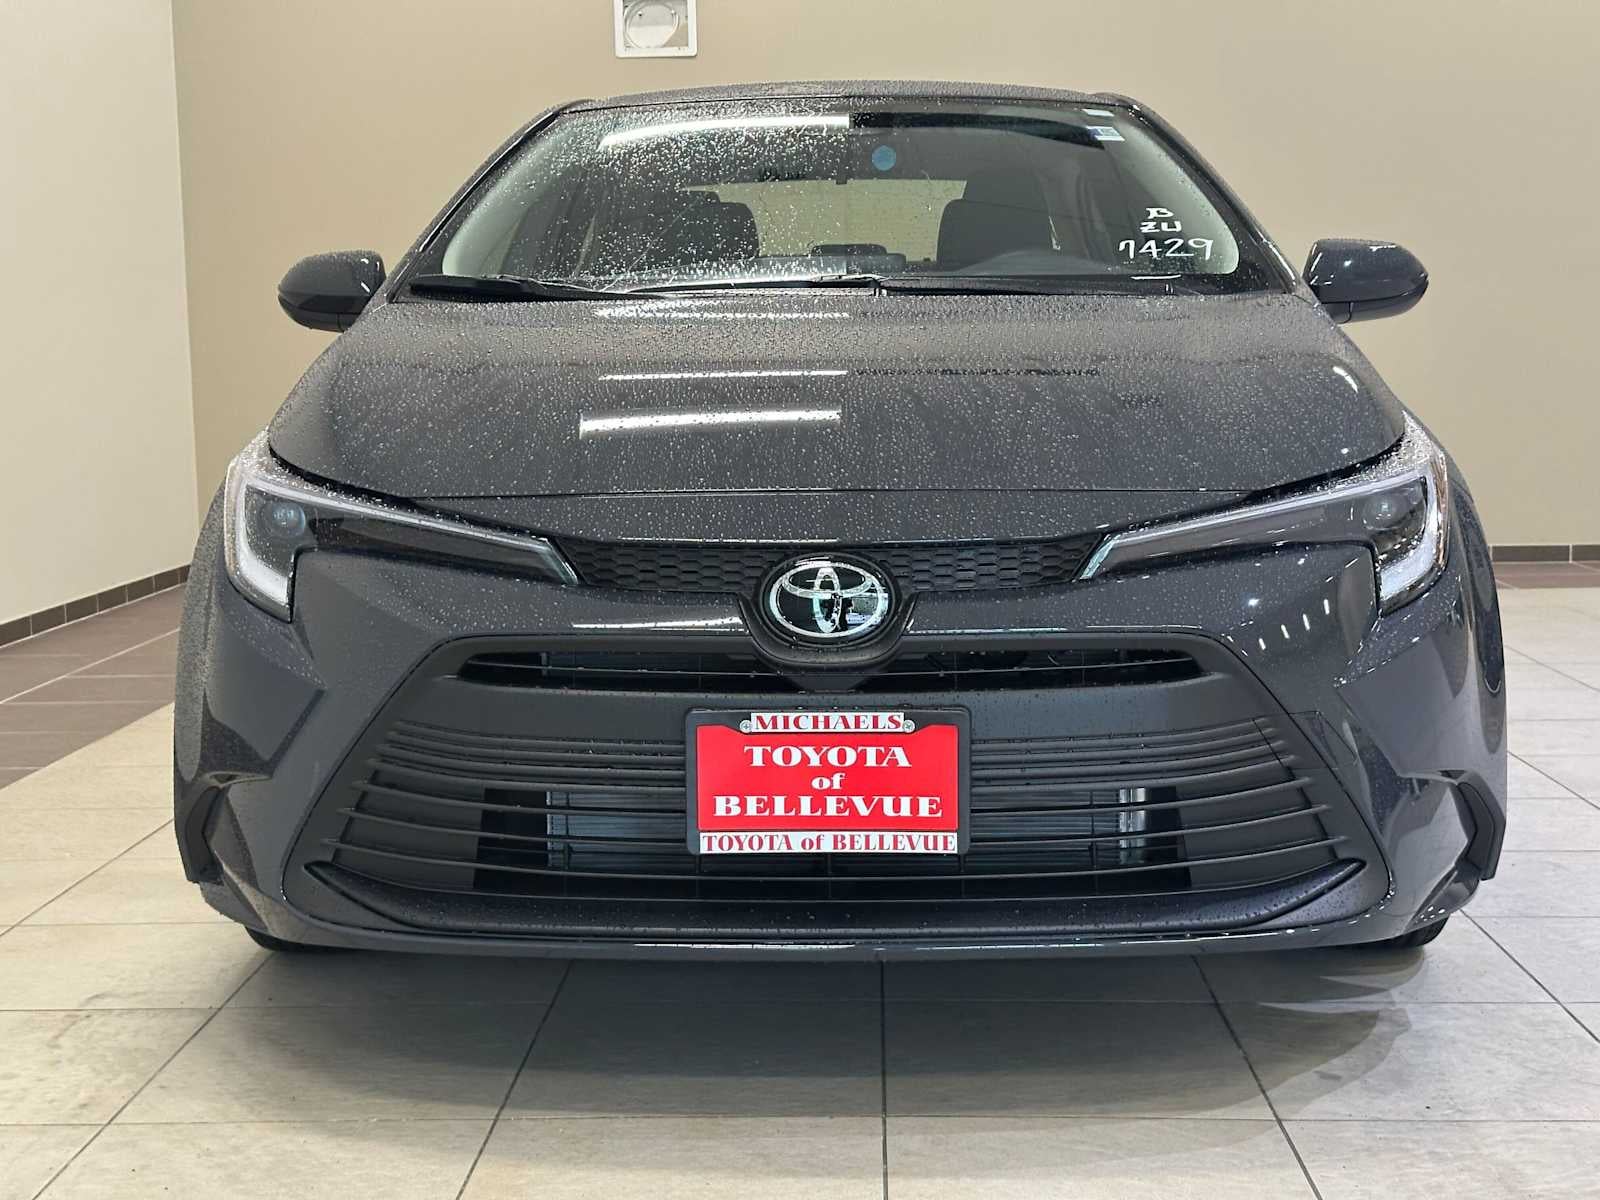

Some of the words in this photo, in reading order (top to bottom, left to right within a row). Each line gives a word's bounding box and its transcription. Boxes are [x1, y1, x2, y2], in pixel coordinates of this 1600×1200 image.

[1118, 238, 1214, 260] 7429
[754, 714, 903, 730] MICHAELS
[743, 746, 912, 767] TOYOTA
[811, 773, 846, 790] of
[713, 795, 943, 818] BELLEVUE
[702, 834, 793, 852] TOYOTA
[800, 834, 825, 851] of
[832, 834, 956, 851] BELLEVUE
